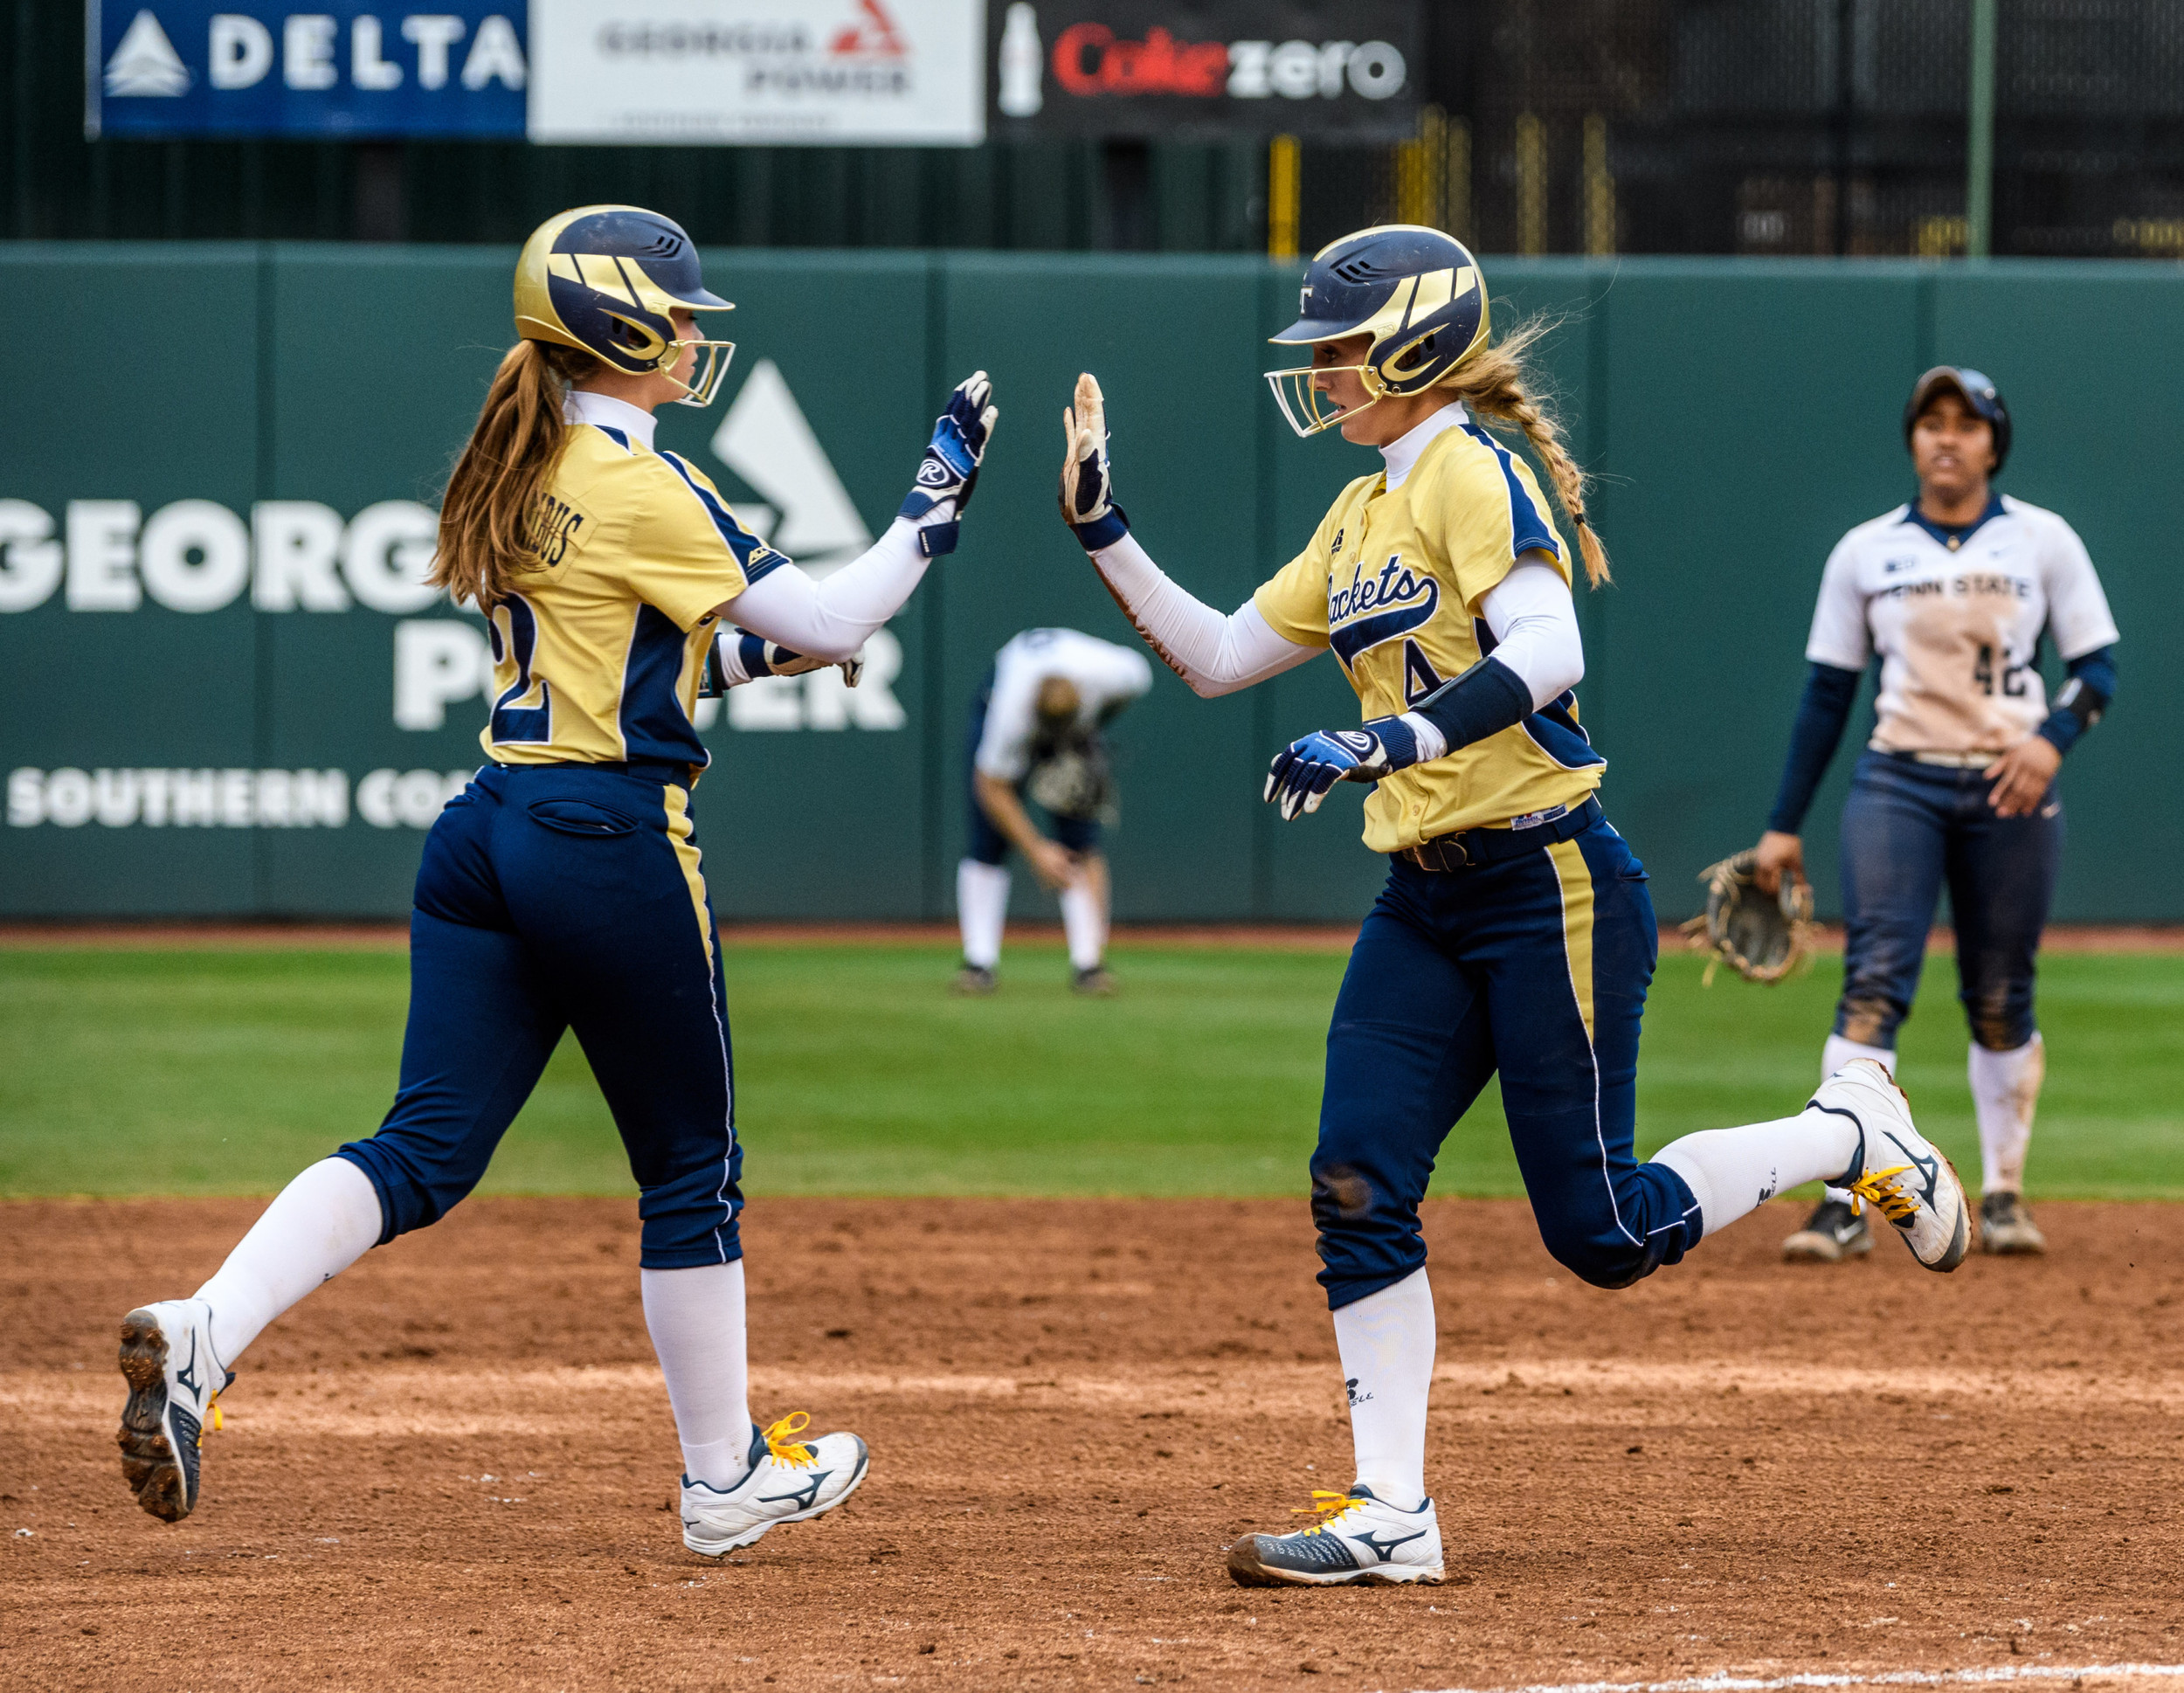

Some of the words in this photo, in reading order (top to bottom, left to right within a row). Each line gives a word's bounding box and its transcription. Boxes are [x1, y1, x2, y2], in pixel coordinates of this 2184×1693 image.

[208, 14, 528, 92] DELTA
[1052, 22, 1229, 97] Coke
[1227, 39, 1407, 100] zero
[0, 499, 482, 613] GEORG
[1402, 636, 1457, 710] 4
[5, 768, 348, 830] SOUTHERN
